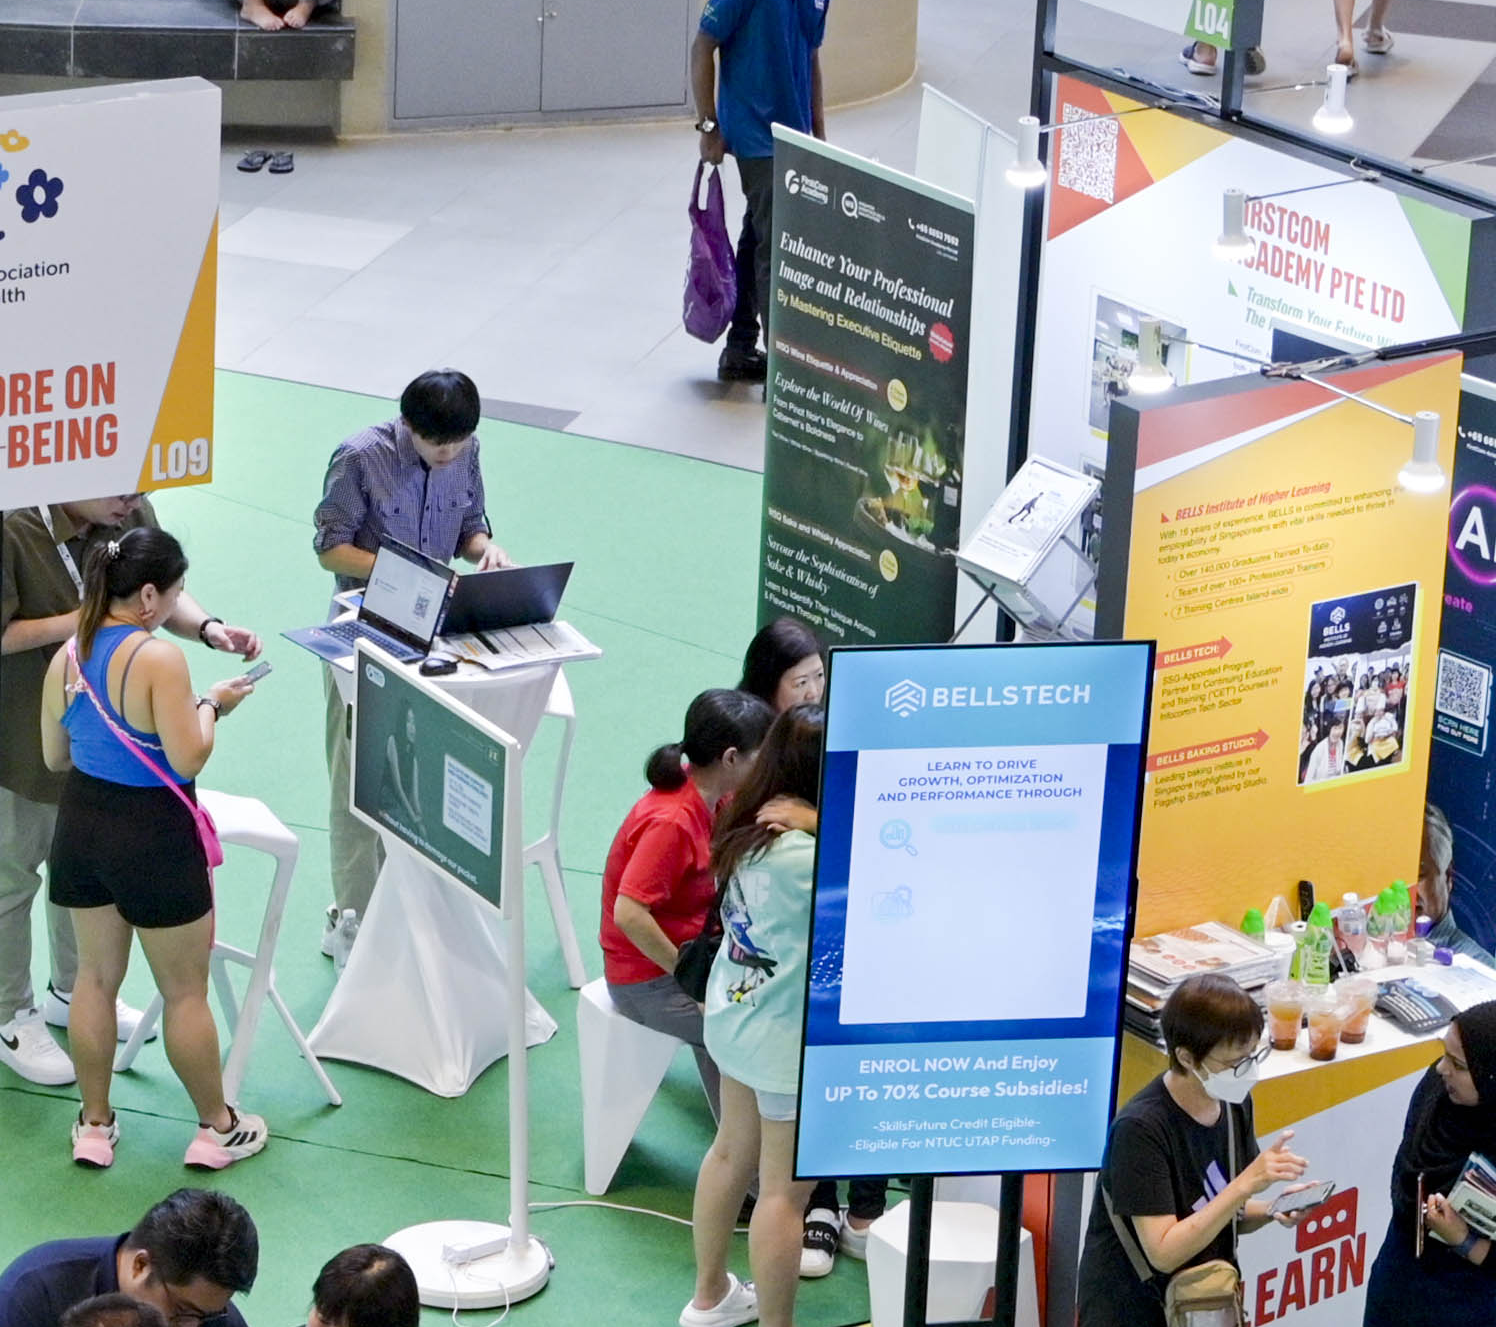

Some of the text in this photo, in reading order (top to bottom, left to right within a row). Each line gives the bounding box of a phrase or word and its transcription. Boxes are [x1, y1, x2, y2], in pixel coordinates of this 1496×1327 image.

[1195, 0, 1229, 40] L04
[779, 231, 954, 319] Enhance Your Professional
[64, 361, 116, 410] ON
[151, 436, 209, 483] L09
[859, 1054, 1059, 1074] ENROL NOW And Enjoy
